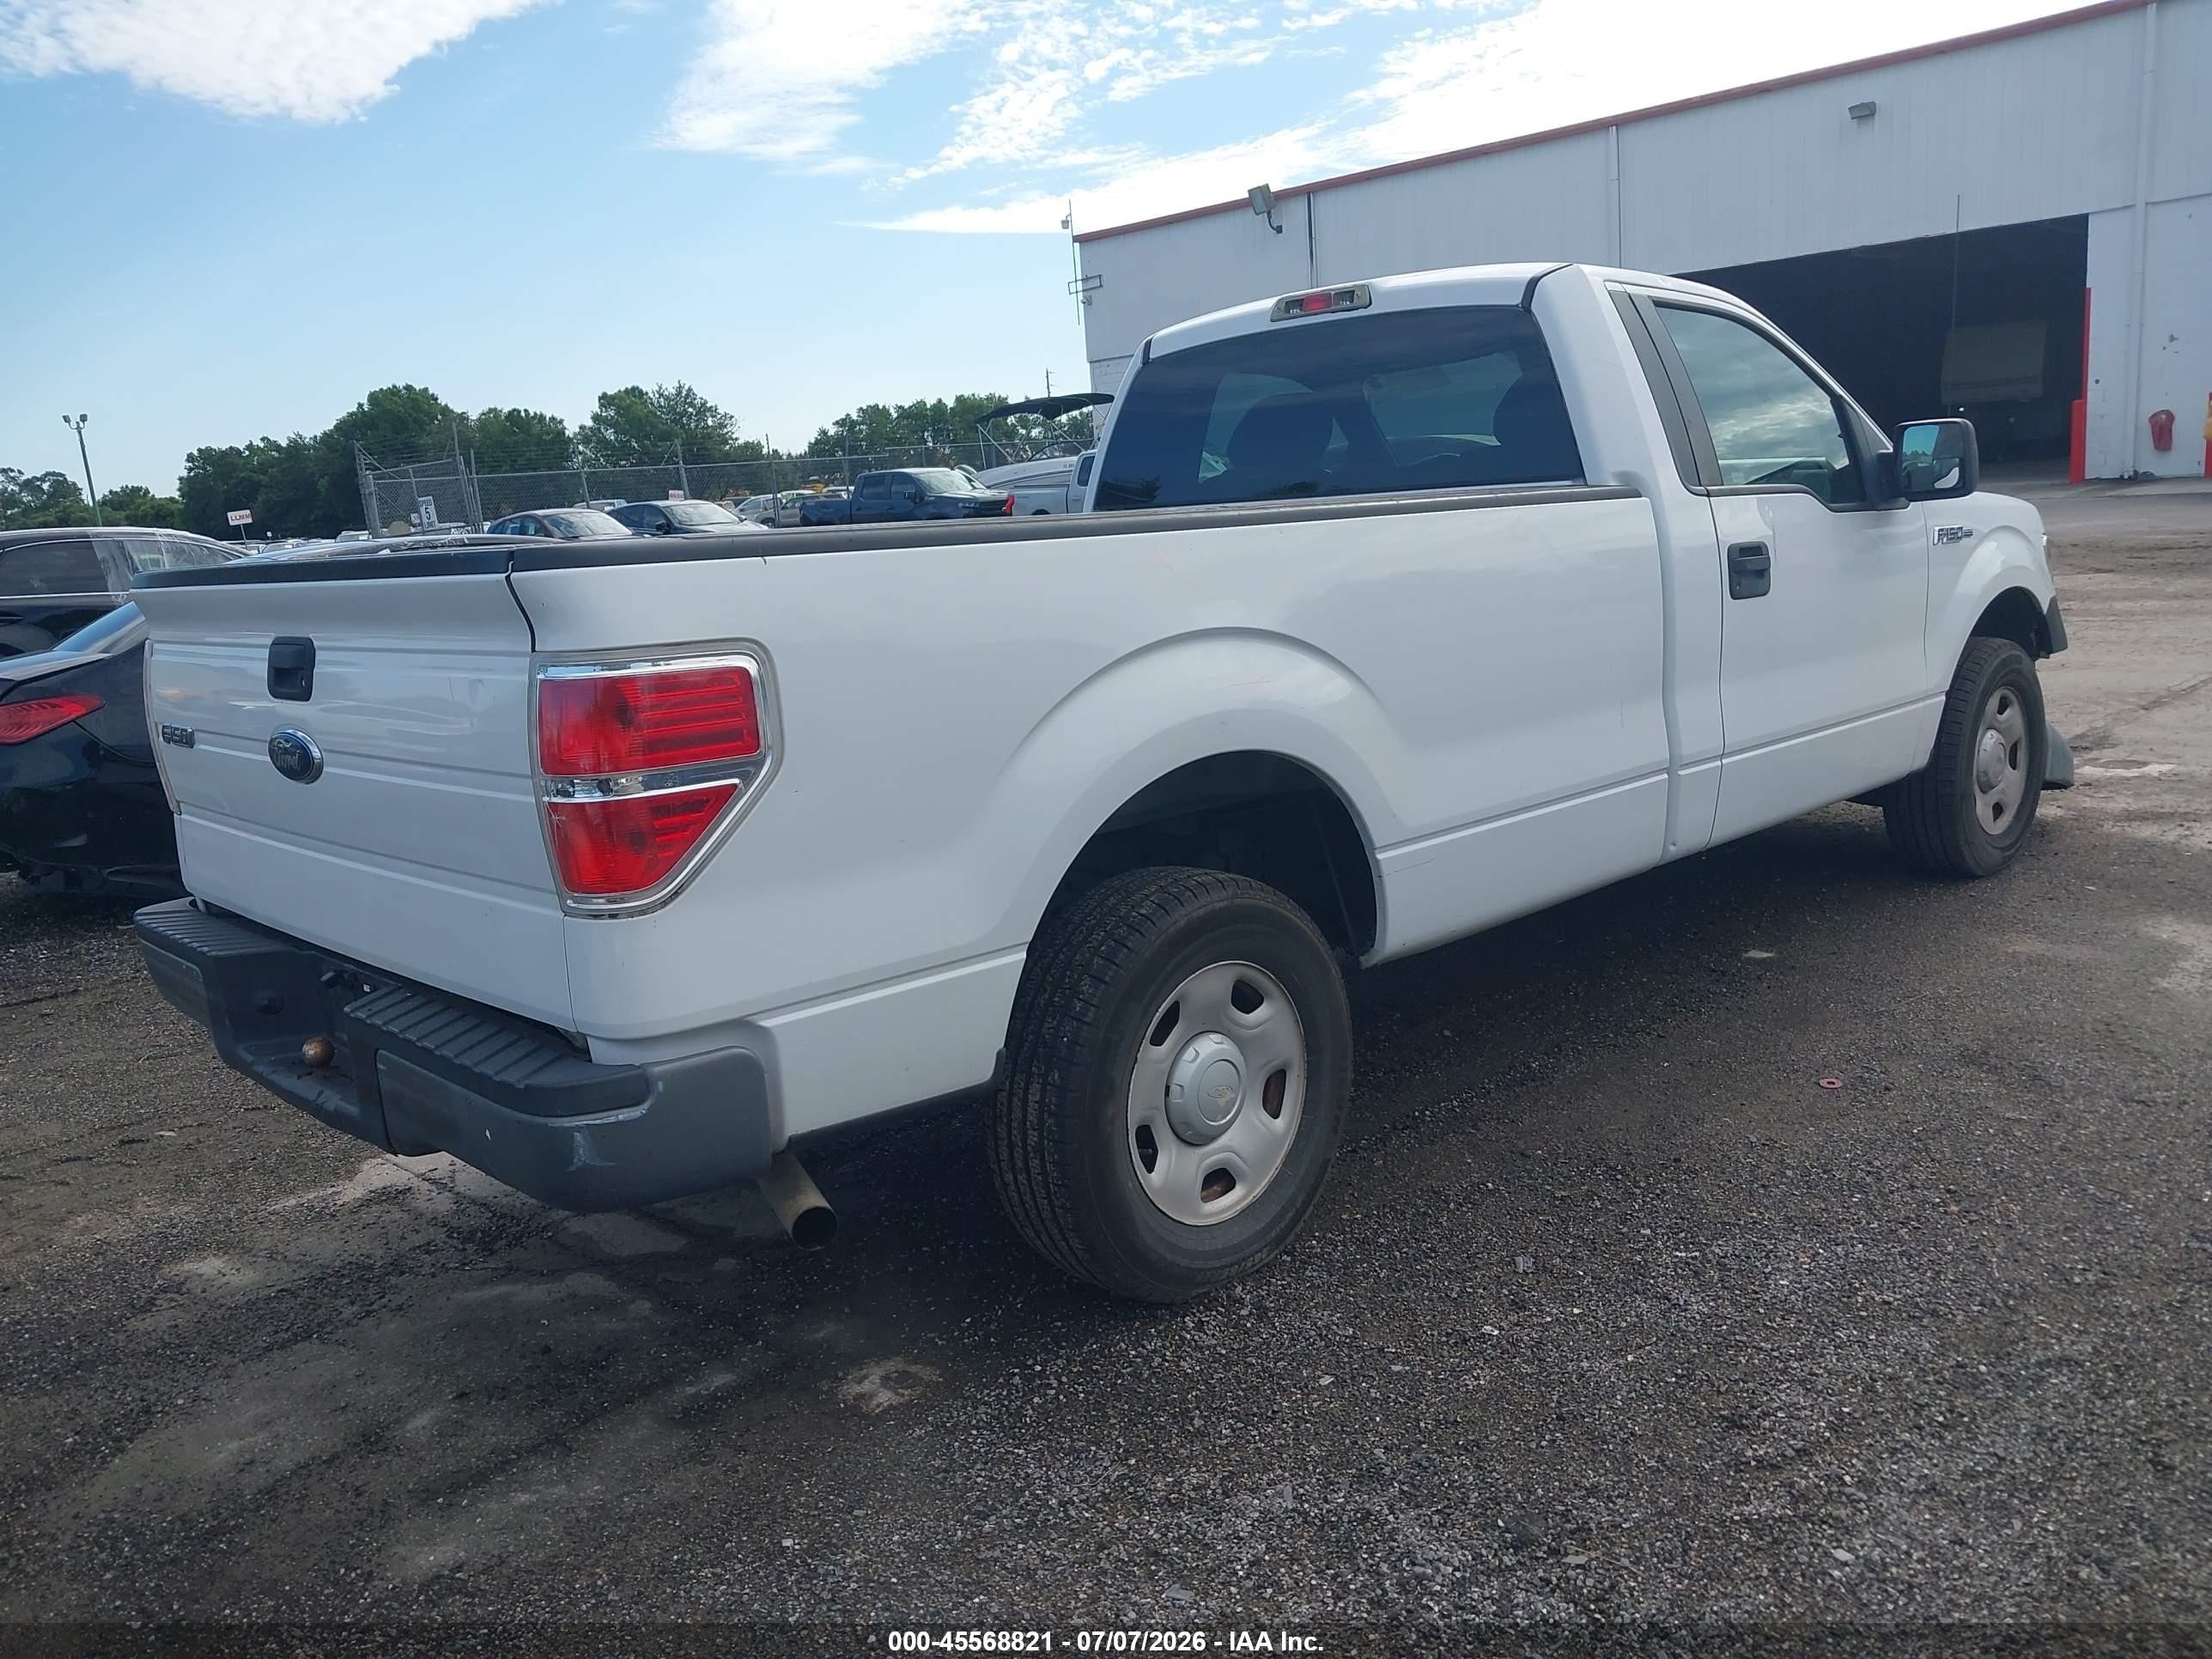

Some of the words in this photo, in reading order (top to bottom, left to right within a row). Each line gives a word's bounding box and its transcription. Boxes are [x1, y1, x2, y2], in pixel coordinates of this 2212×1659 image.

[418, 499, 433, 507] SPEED
[424, 507, 431, 520] 5
[424, 520, 436, 529] LIMIT
[274, 738, 302, 771] Ford
